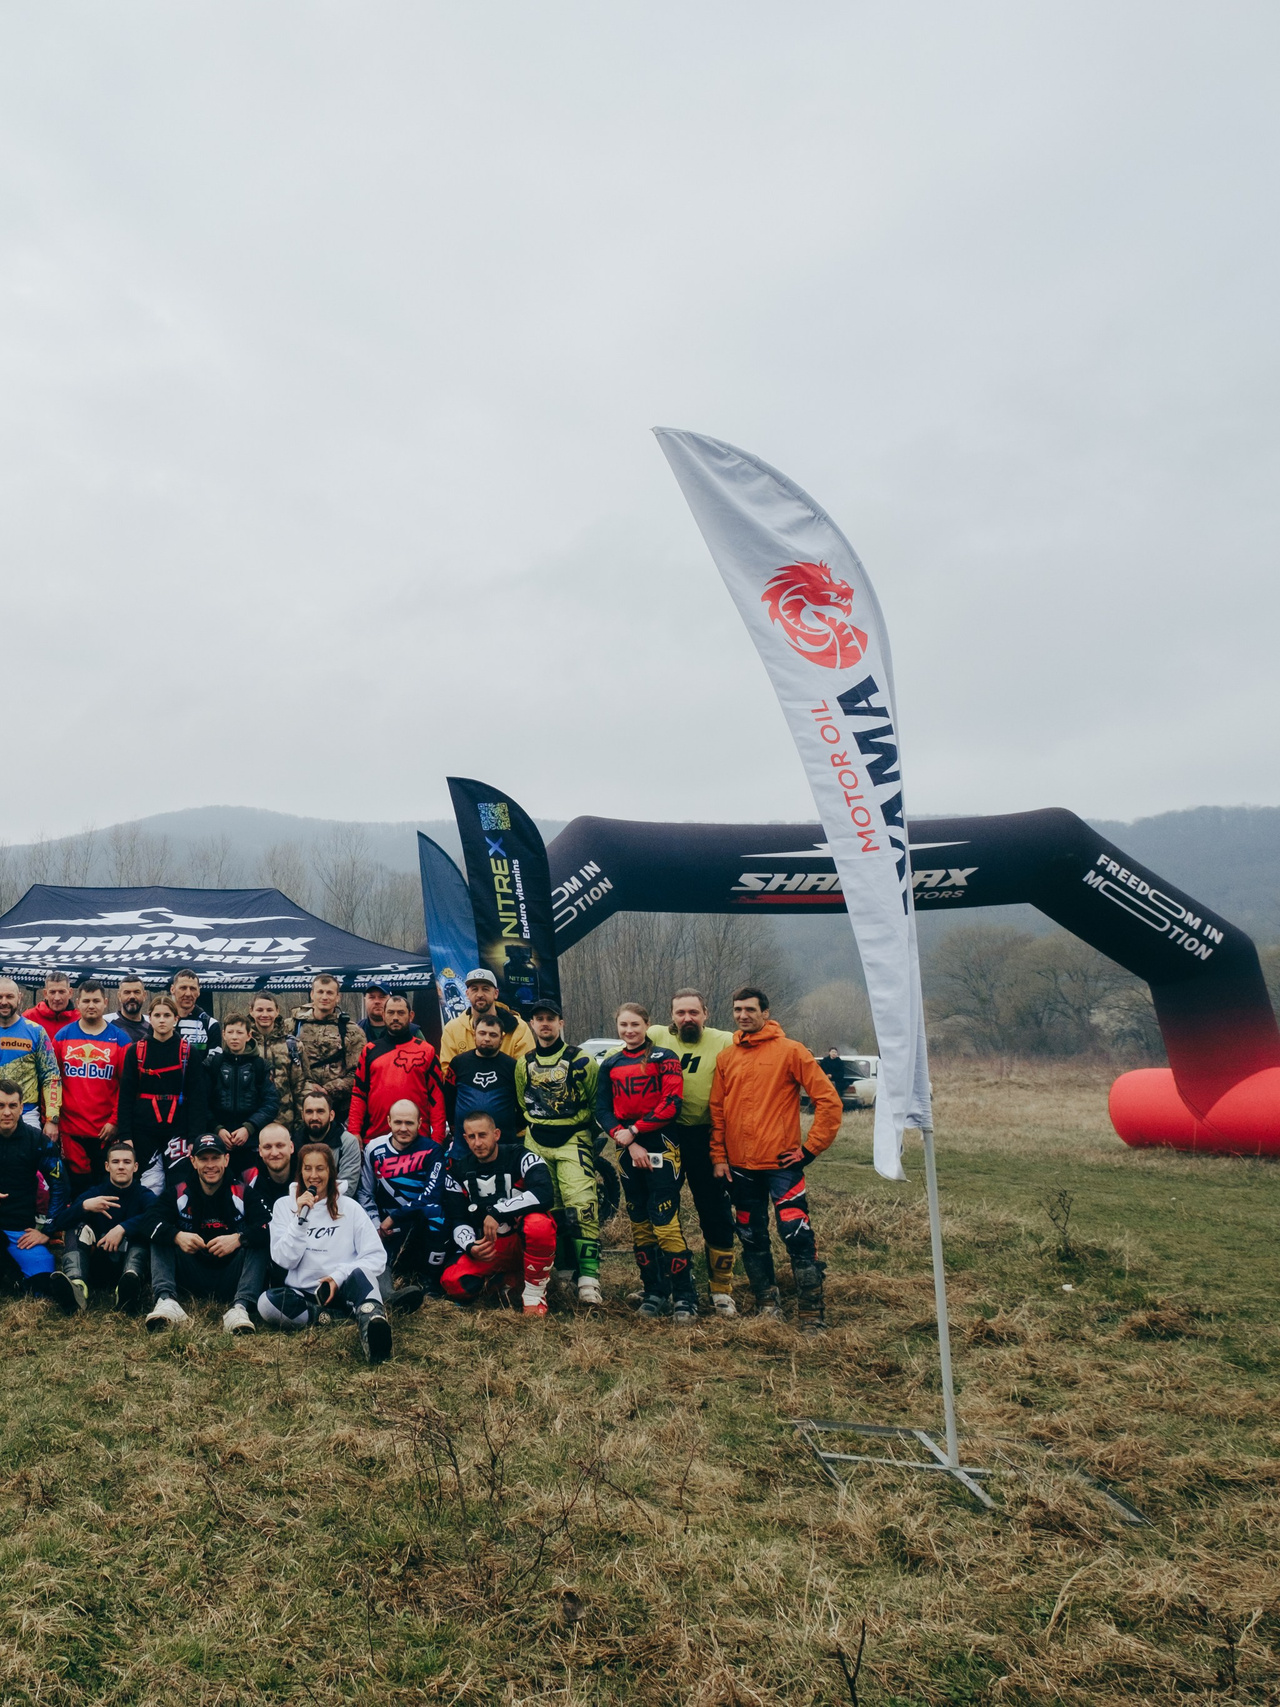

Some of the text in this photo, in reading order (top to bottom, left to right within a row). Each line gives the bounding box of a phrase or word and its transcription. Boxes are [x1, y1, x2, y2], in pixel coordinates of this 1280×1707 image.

[811, 699, 880, 853] MOTOR OIL
[485, 836, 520, 938] NITREX
[579, 860, 601, 881] IN
[512, 859, 530, 939] Enduro vitamins
[1082, 870, 1214, 961] MOTION
[1096, 854, 1224, 945] FREEDOM IN
[193, 954, 307, 965] RACE
[354, 972, 434, 982] SHARMAX
[64, 1062, 114, 1080] Red Bull
[314, 1225, 340, 1239] CAT
